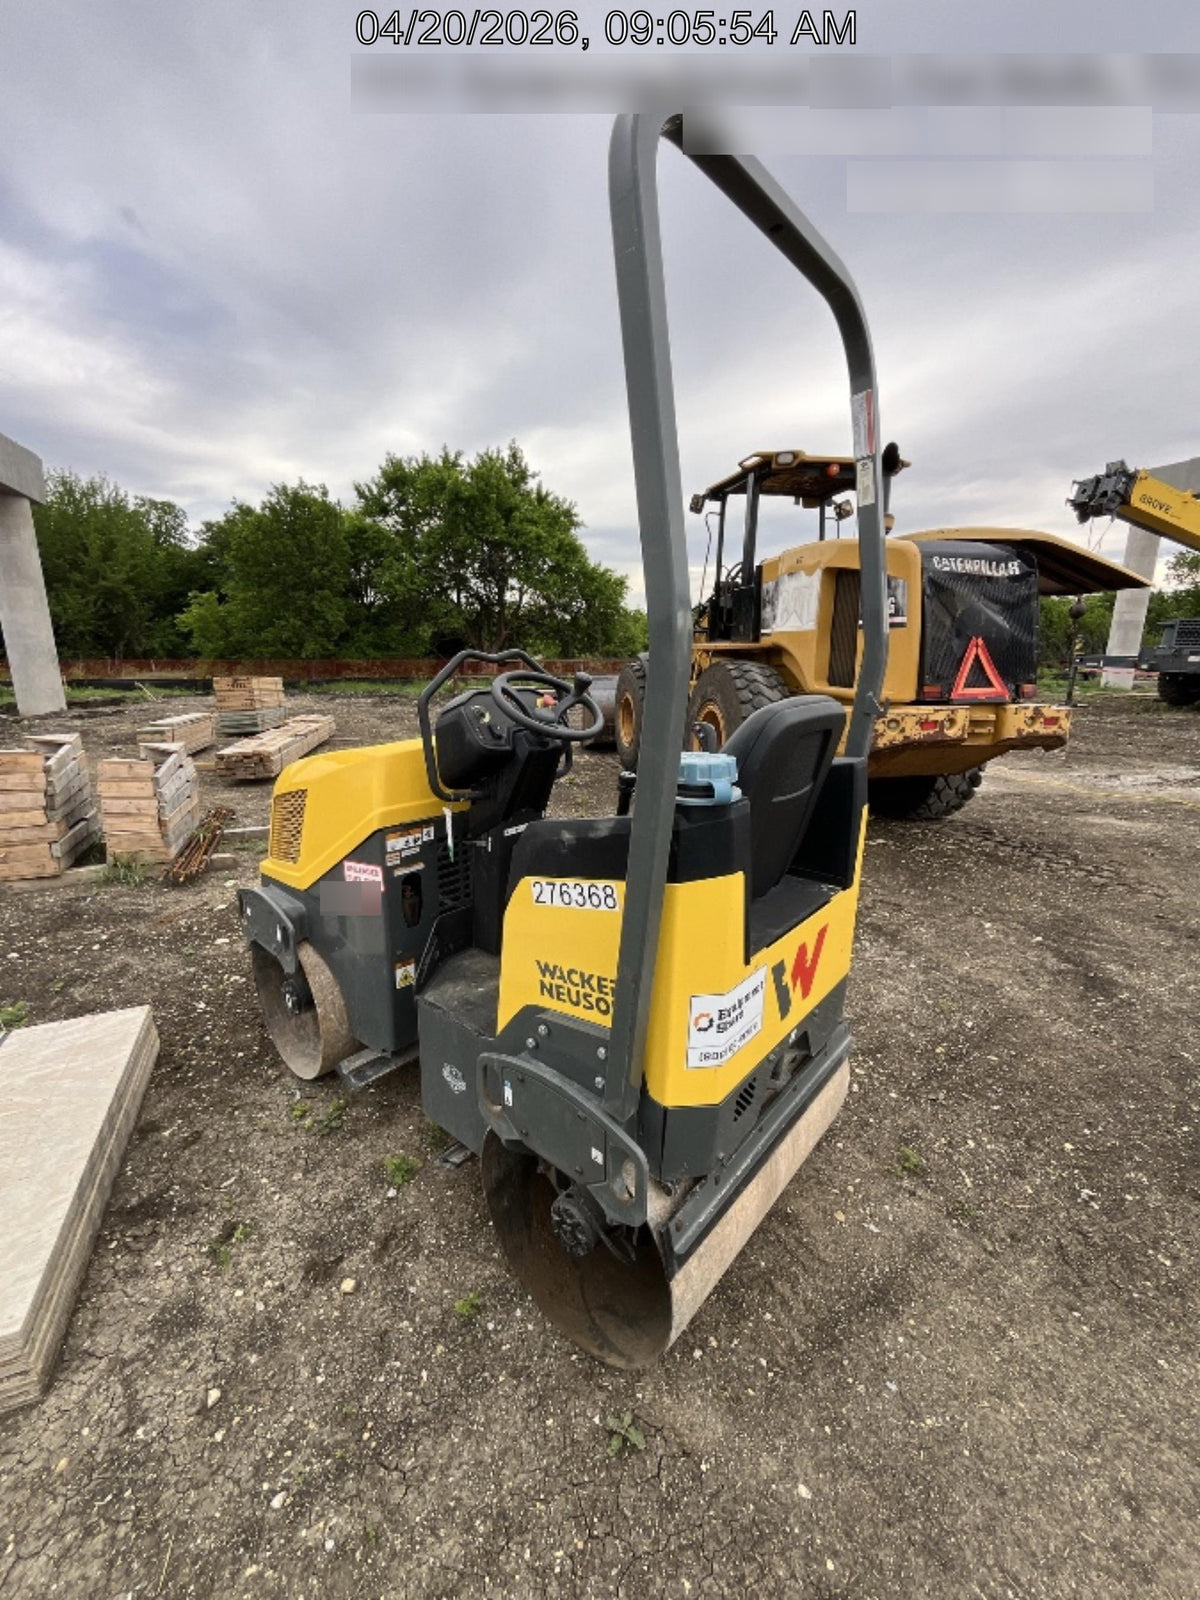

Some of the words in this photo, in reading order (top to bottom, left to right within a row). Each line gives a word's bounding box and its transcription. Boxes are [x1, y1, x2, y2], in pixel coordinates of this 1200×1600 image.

[1140, 494, 1173, 514] GROVE
[933, 556, 1021, 576] CATERPILLAR
[533, 881, 617, 909] 276368
[539, 979, 615, 1016] NEUSO
